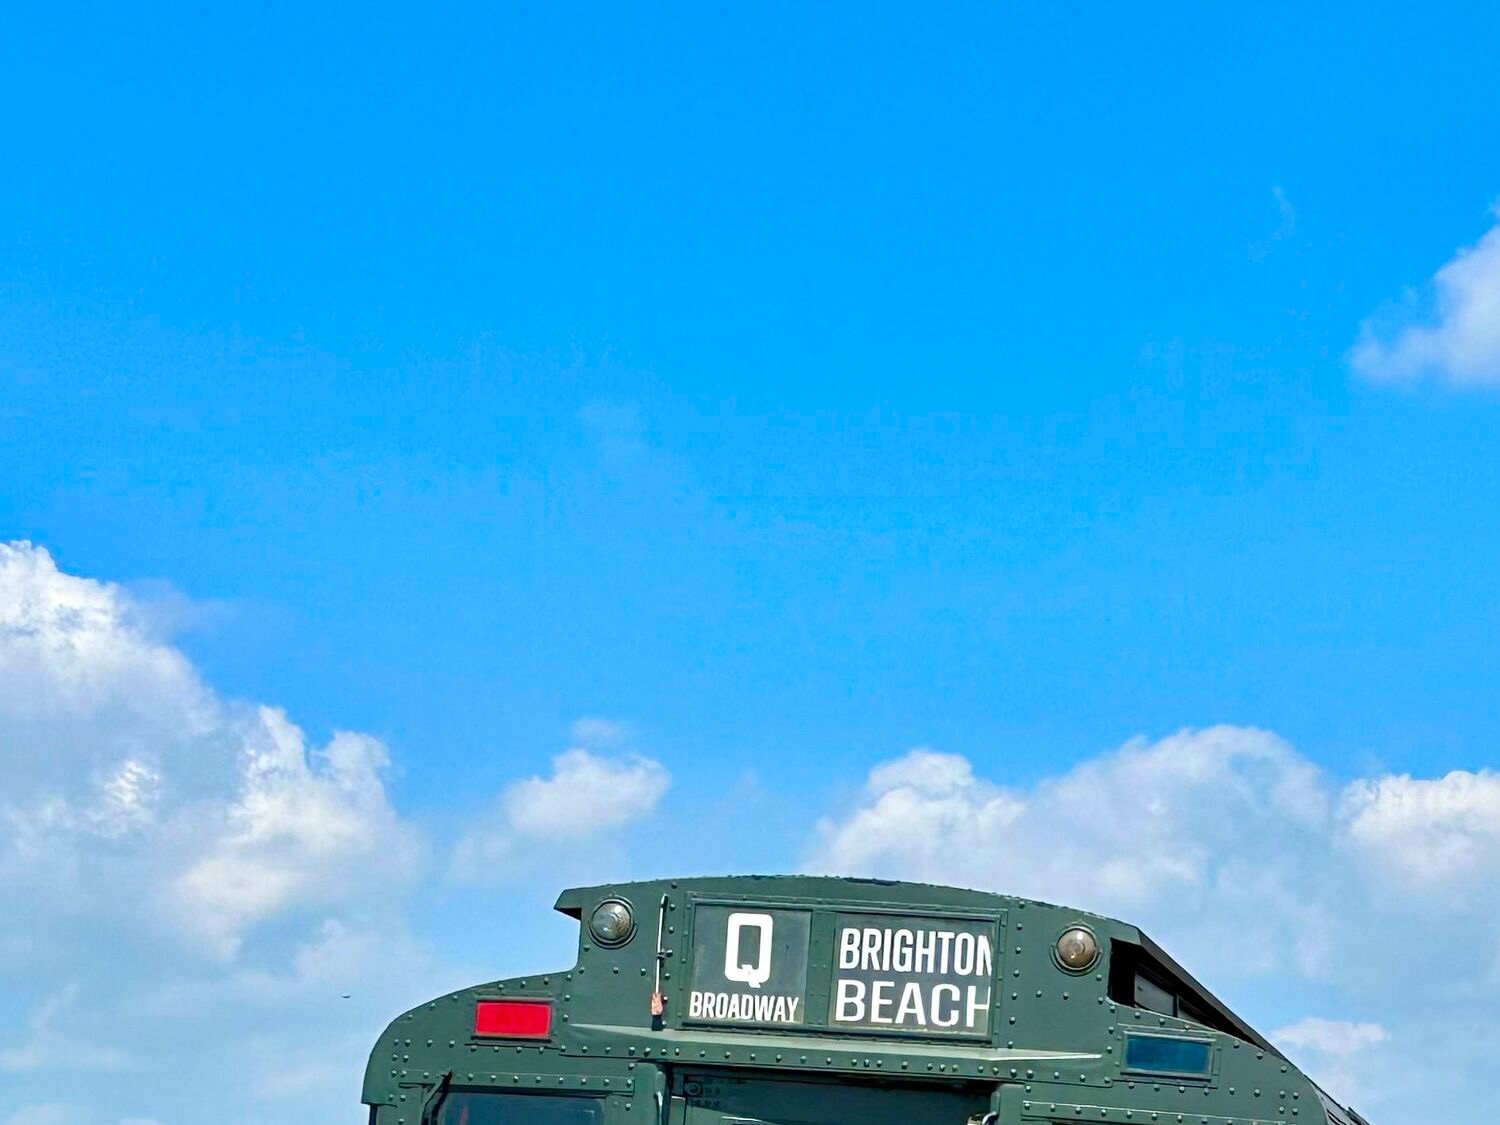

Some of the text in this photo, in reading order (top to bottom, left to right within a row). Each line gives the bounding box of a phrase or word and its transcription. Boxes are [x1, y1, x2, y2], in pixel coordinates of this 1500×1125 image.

[724, 912, 774, 989] Q
[839, 927, 993, 976] BRIGHTON
[689, 991, 800, 1023] BROADWAY
[834, 979, 992, 1028] BEACH
